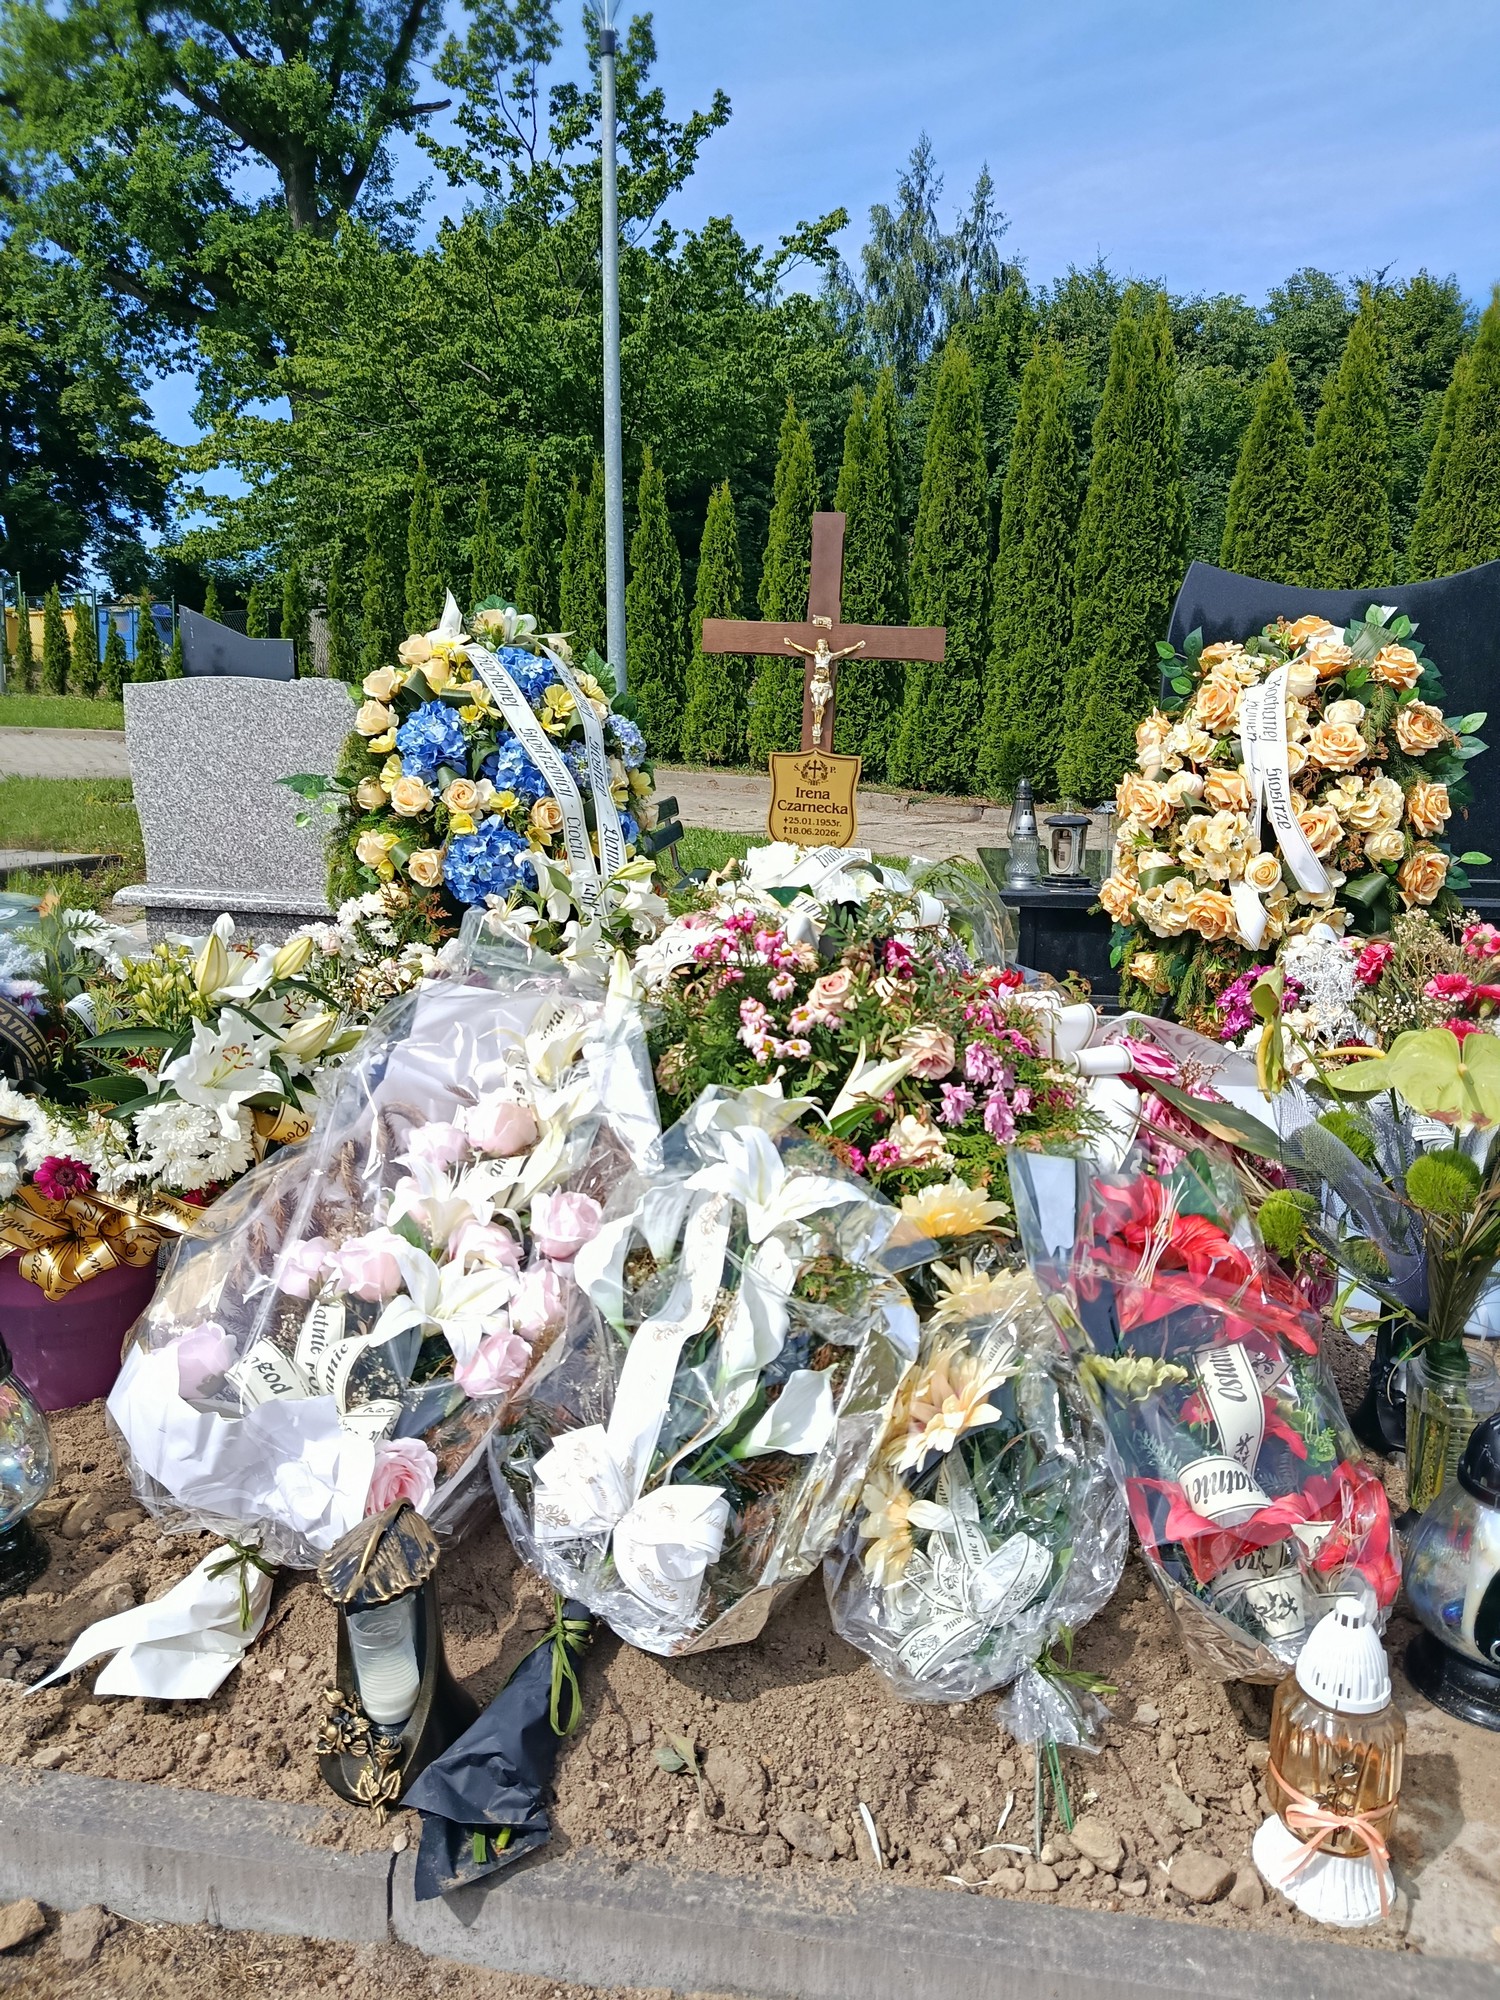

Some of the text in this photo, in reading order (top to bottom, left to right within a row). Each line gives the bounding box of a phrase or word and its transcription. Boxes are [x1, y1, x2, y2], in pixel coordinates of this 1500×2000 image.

[1260, 675, 1292, 830] Kochanej Siostrze
[519, 727, 575, 798] Siostrzenicy
[566, 815, 587, 861] Ciocia
[777, 799, 848, 815] Czarnecka
[795, 786, 830, 800] Irena
